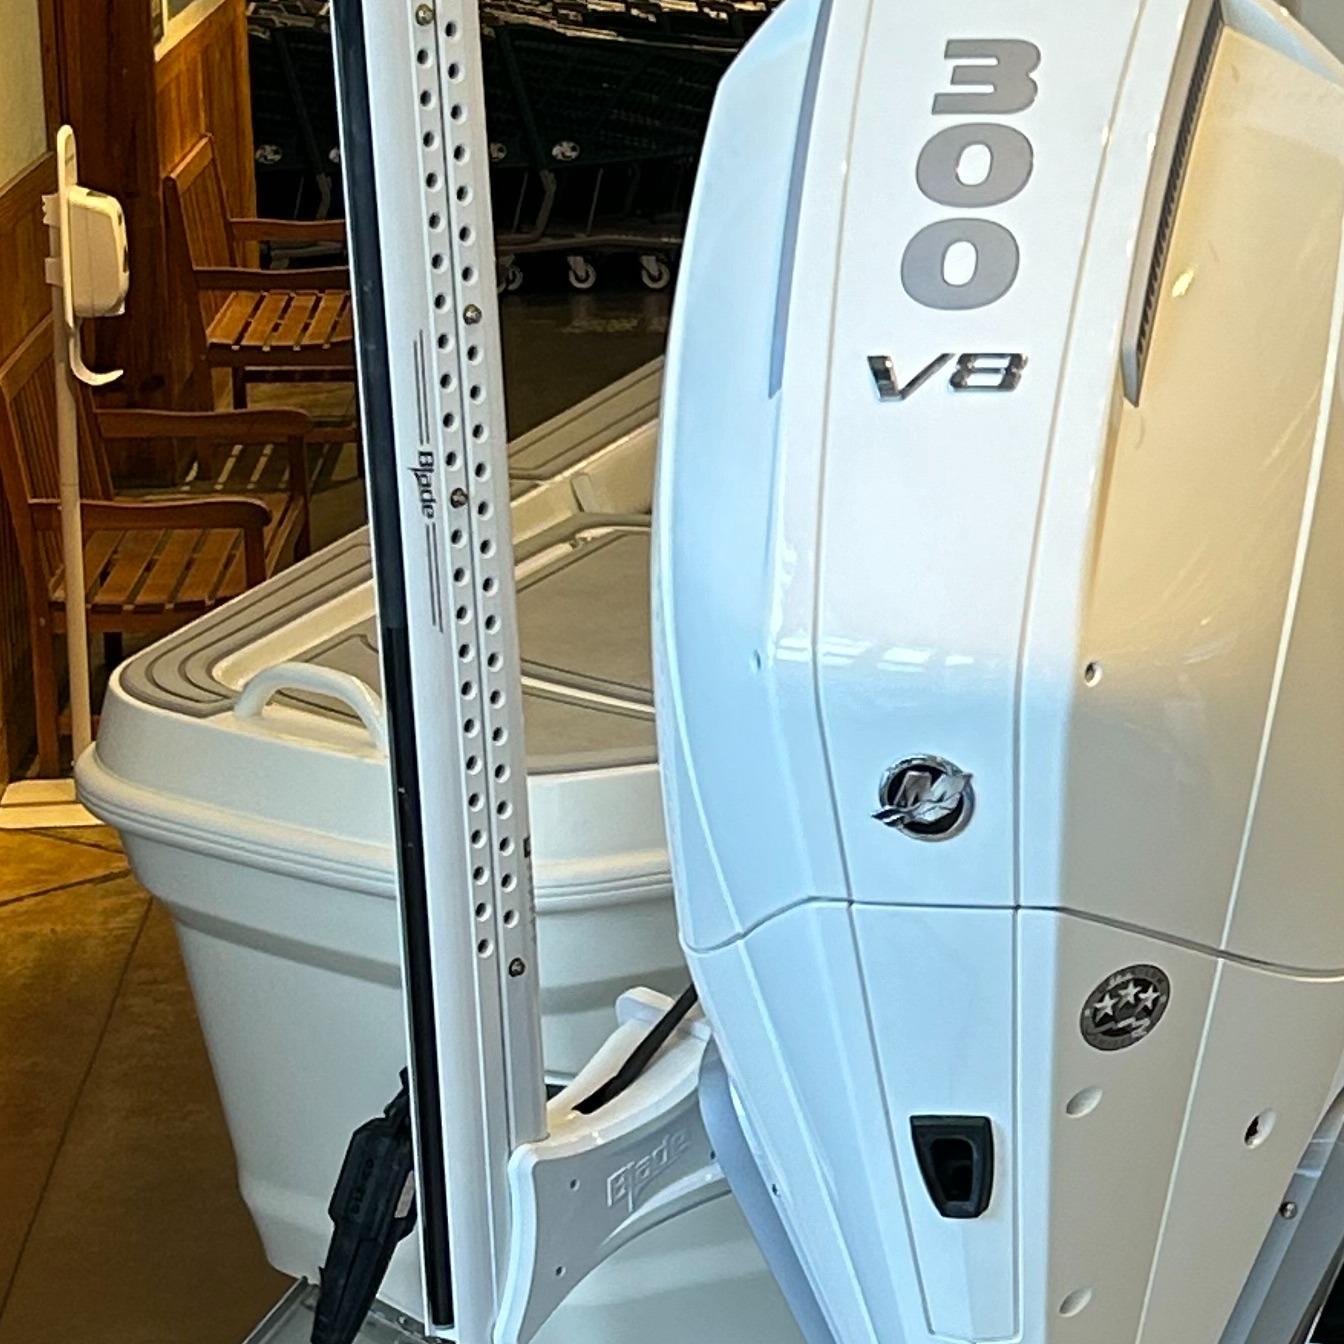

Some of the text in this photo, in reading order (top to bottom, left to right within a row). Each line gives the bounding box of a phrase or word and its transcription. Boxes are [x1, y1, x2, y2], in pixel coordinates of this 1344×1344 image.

[900, 38, 1042, 310] 300
[867, 352, 1029, 402] V8
[407, 450, 436, 519] Blade
